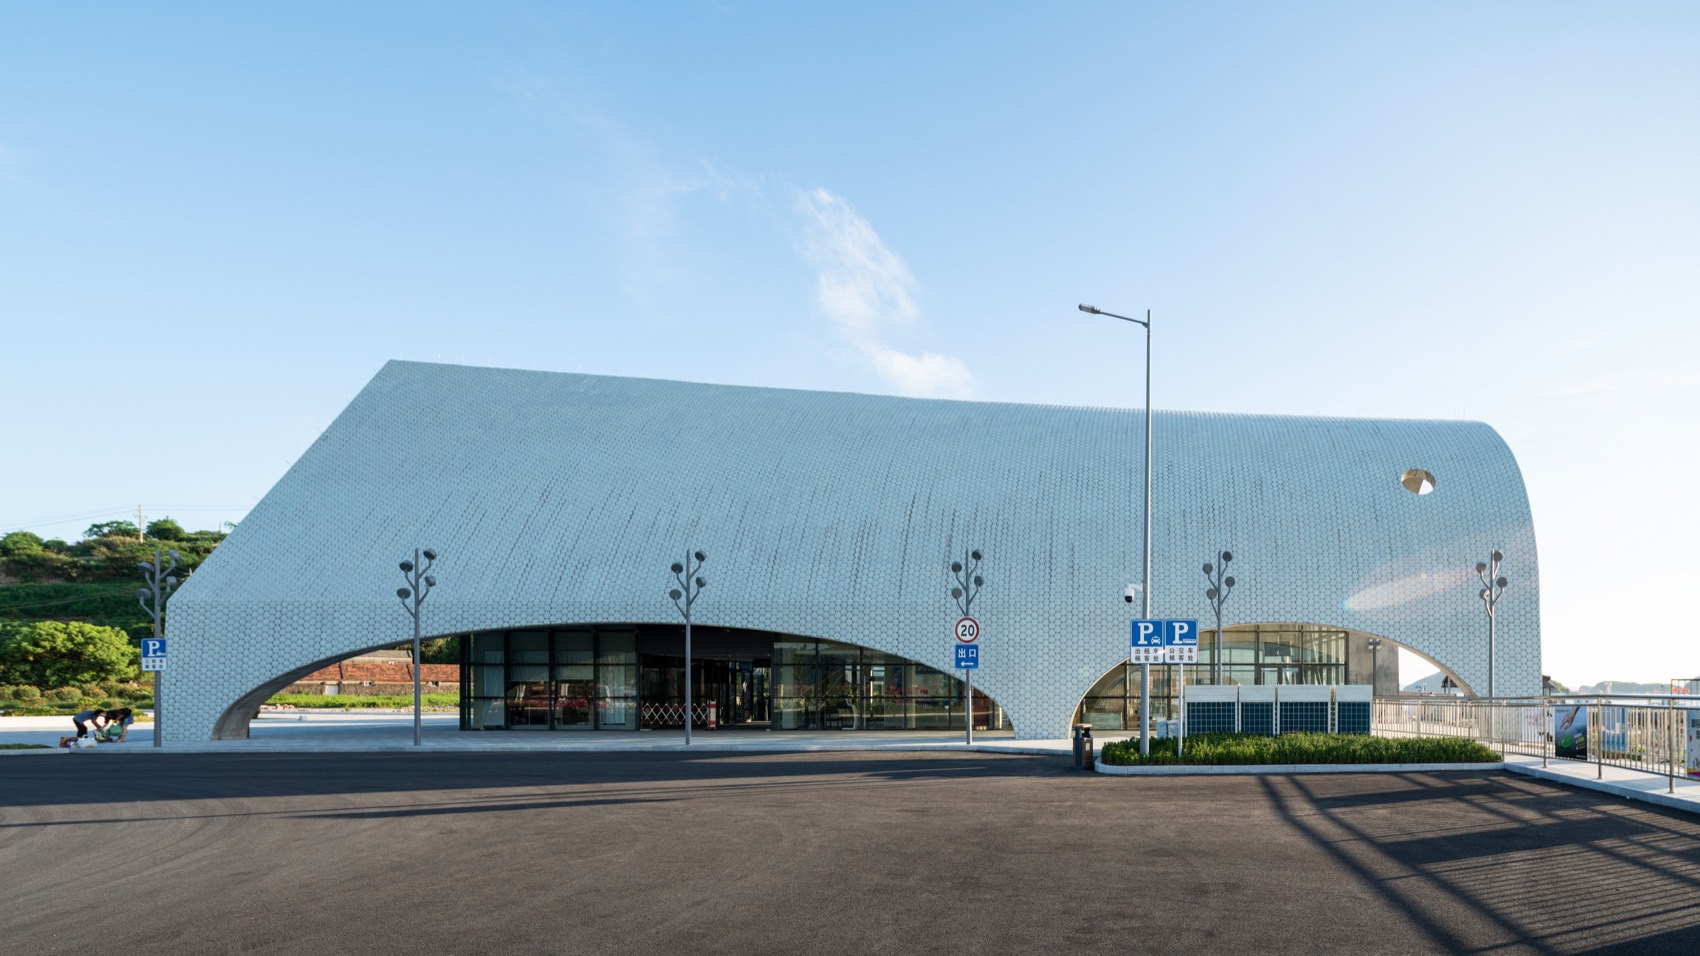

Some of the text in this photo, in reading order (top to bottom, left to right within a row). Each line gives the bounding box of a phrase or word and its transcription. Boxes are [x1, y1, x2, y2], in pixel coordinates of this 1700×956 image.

[961, 624, 975, 637] 20
[1138, 622, 1154, 644] P
[1173, 622, 1188, 644] P
[147, 641, 160, 656] P
[958, 648, 976, 658] 出口
